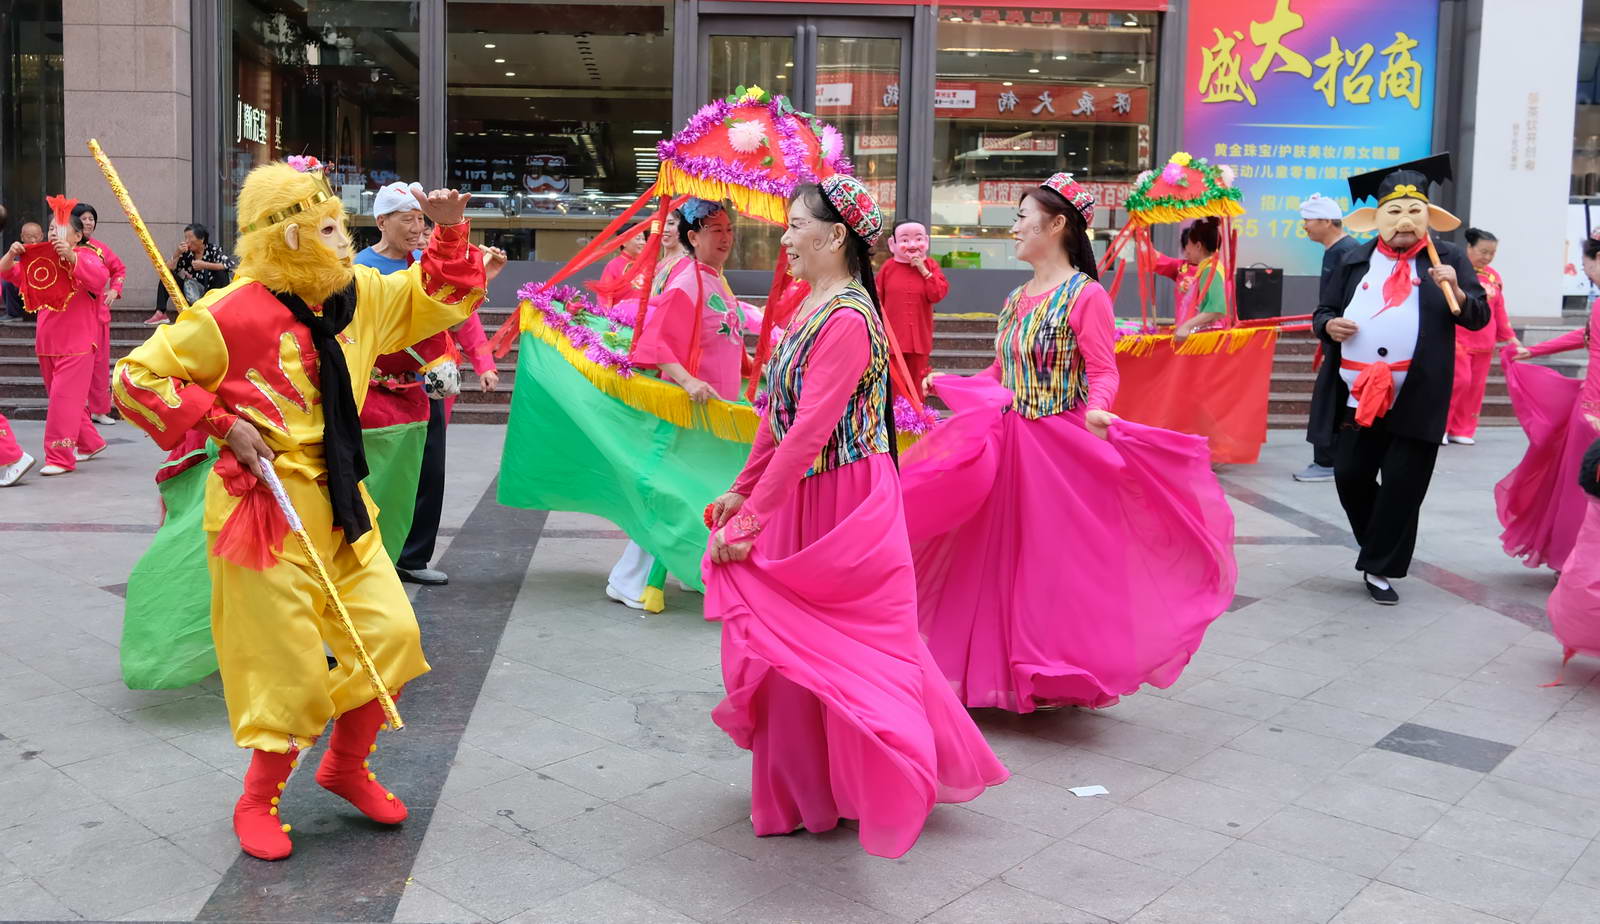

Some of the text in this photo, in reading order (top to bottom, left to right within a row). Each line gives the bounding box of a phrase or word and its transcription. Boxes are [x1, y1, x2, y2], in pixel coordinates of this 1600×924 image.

[1198, 0, 1423, 108] 盛大招商
[1215, 143, 1401, 160] 黄金珠宝/护肤美妆/男女鞋服
